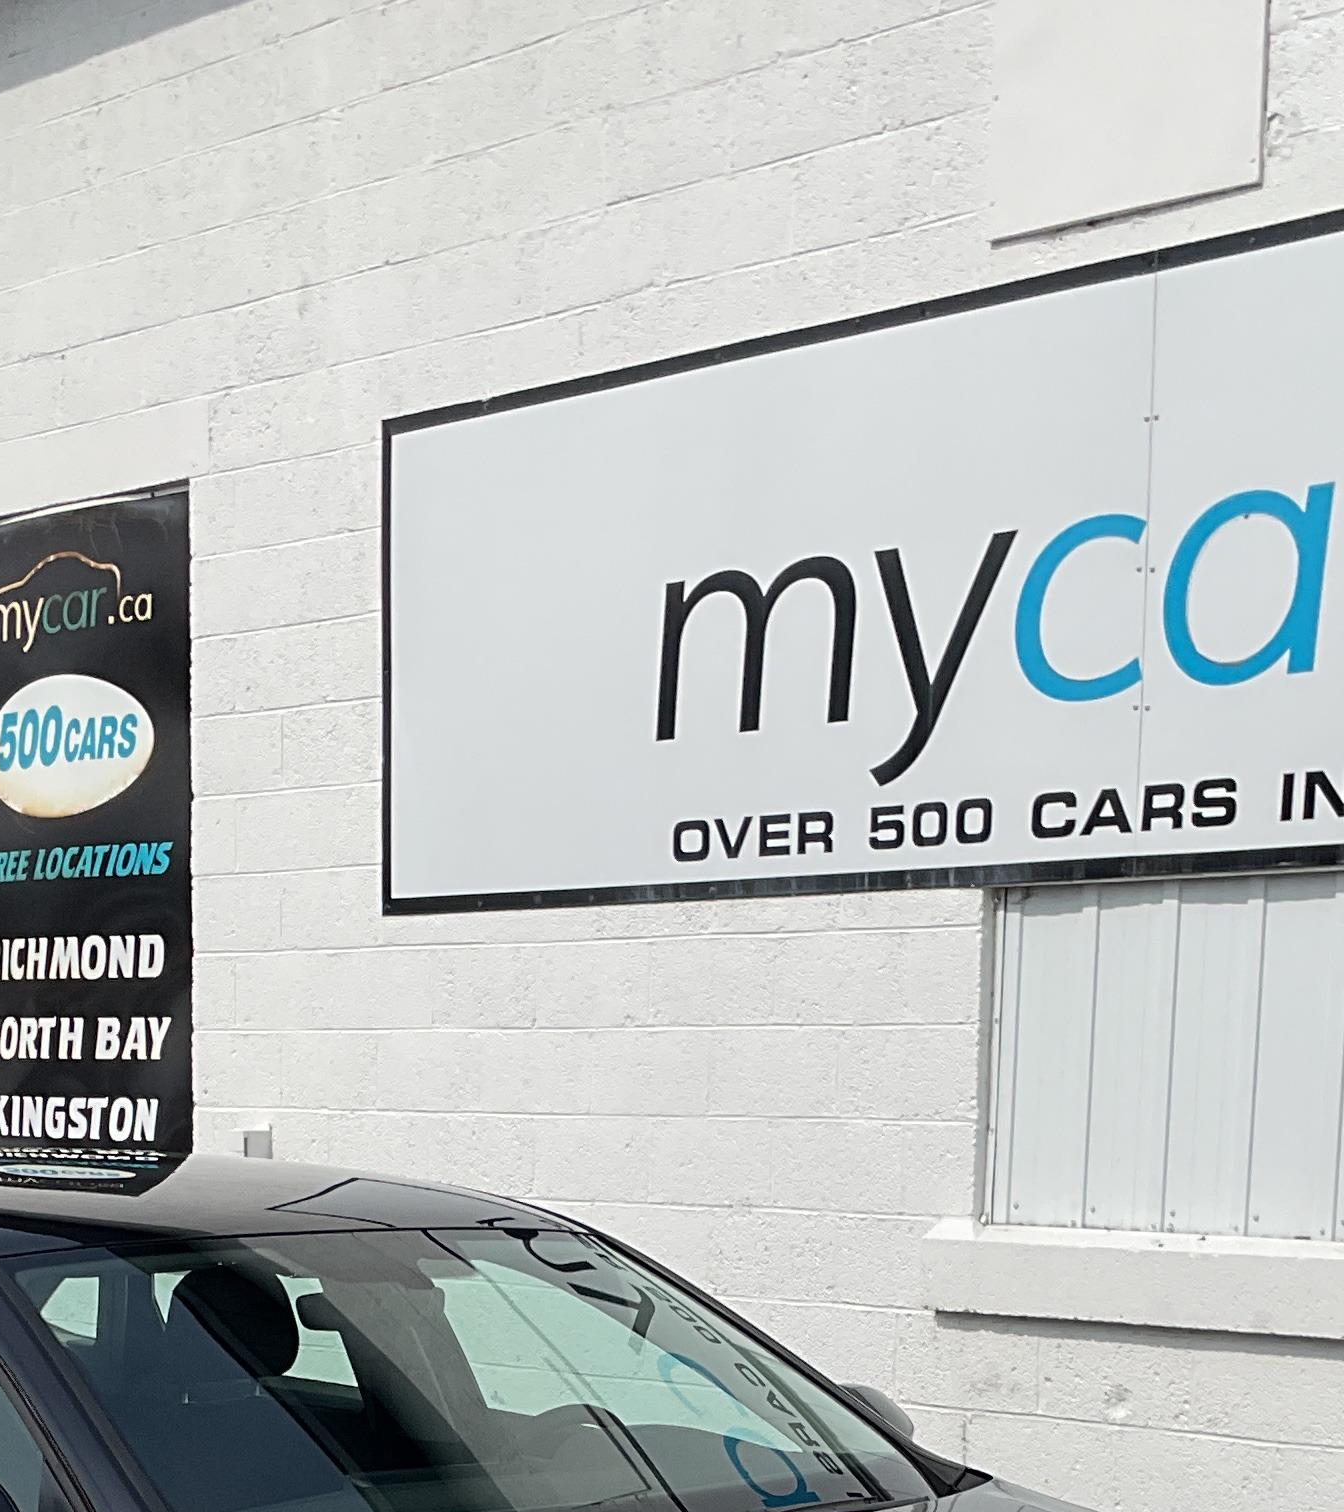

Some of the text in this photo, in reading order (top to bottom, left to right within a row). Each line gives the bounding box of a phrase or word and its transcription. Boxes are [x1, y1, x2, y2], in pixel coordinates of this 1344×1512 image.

[672, 811, 835, 862] OVER
[868, 798, 993, 850] 500
[1031, 778, 1238, 839] CARS
[33, 842, 173, 881] LOCATIONS
[95, 1017, 172, 1060] BAY
